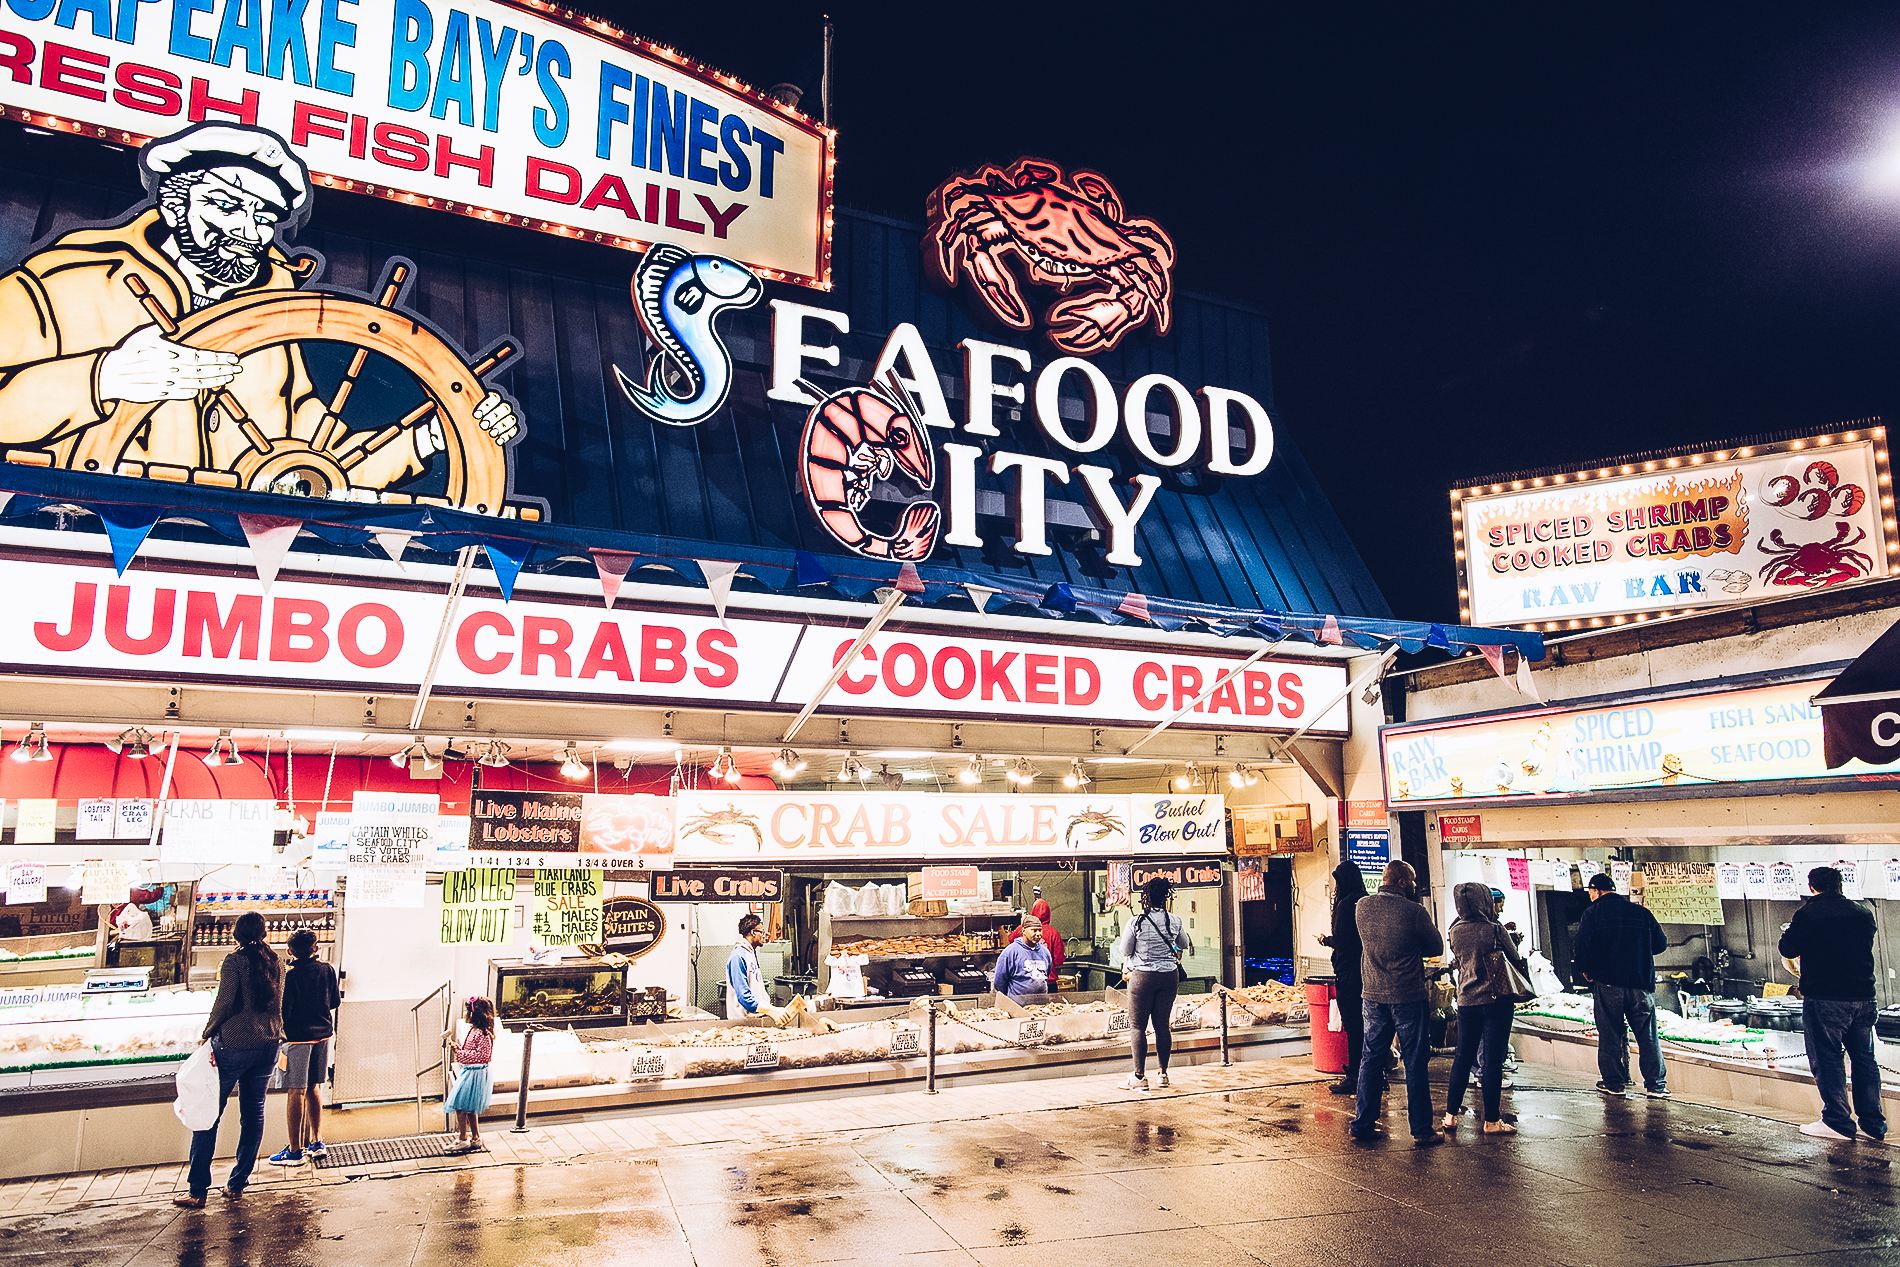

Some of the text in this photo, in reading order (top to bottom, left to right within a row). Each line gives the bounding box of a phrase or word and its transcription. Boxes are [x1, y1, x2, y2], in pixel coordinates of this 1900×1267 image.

[10, 0, 785, 200] EAKE BAY'S FINEST
[291, 100, 494, 188] FISH
[524, 157, 749, 239] DAILY
[1489, 496, 1731, 548] SPICED SHRIMP
[1492, 522, 1734, 573] COOKED CRABS
[1521, 570, 1707, 611] RAW BAR
[34, 581, 740, 689] JUMBO CRABS
[832, 638, 1306, 719] COOKED CRABS
[1574, 707, 1655, 745] SPICED
[1710, 706, 1757, 730] FISH
[1392, 732, 1438, 775] RAW
[1573, 741, 1664, 775] SHRIMP
[1711, 738, 1812, 765] SEAFOOD
[1408, 754, 1450, 792] BAR
[84, 805, 111, 814] LOBSTER
[170, 800, 271, 820] CRAB MEAT
[355, 801, 437, 814] JUMBO JUMBO
[474, 799, 583, 821] Live Maine
[1154, 799, 1206, 820] Bushel
[90, 814, 104, 822] TAIL
[318, 817, 350, 826] JUMBO
[437, 819, 468, 828] JUMBO
[770, 802, 1058, 849] CRAB SALE
[1444, 817, 1475, 825] FOOD STAMP
[352, 826, 429, 840] CAPTAIN WHITES
[482, 822, 572, 843] Lobsters
[1138, 818, 1221, 844] Blow Out!
[356, 838, 421, 849] SEAFOOD CITY
[364, 846, 410, 856] IS VOTED
[350, 854, 378, 863] BEST
[611, 859, 633, 868] OVER
[13, 877, 41, 885] SCALLOPS
[930, 868, 971, 877] FOOD STAMP
[1185, 865, 1221, 883] Crabs
[534, 881, 597, 896] BLUE CRABS
[655, 875, 778, 897] Live Crabs
[940, 878, 961, 886] CARDS
[1364, 878, 1384, 889] OST
[925, 887, 976, 897] ACCEPTED HERE
[546, 895, 586, 911] SALE
[534, 908, 599, 923] #1 MALES
[441, 908, 510, 944] BLOW OUT
[533, 922, 598, 934] #2 MALES
[542, 932, 595, 946] TODAY ONLY
